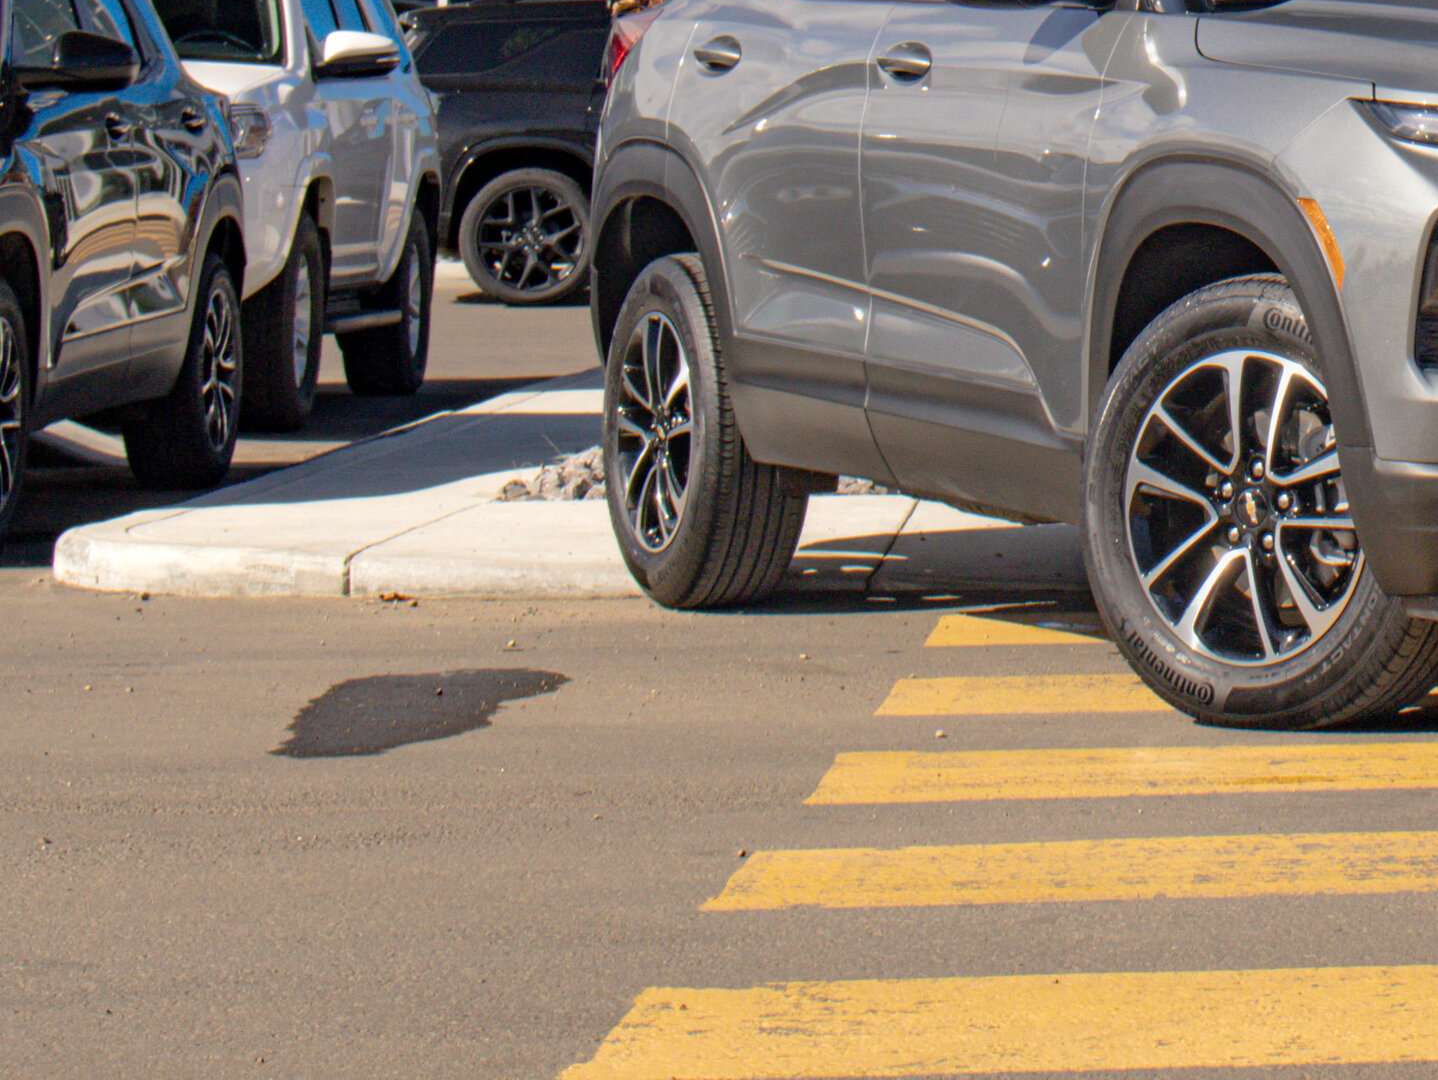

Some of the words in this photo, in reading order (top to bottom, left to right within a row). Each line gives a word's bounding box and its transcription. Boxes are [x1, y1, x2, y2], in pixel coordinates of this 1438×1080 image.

[1263, 306, 1313, 345] Contin
[1126, 629, 1216, 706] Continental
[1321, 584, 1381, 675] ONTACT
